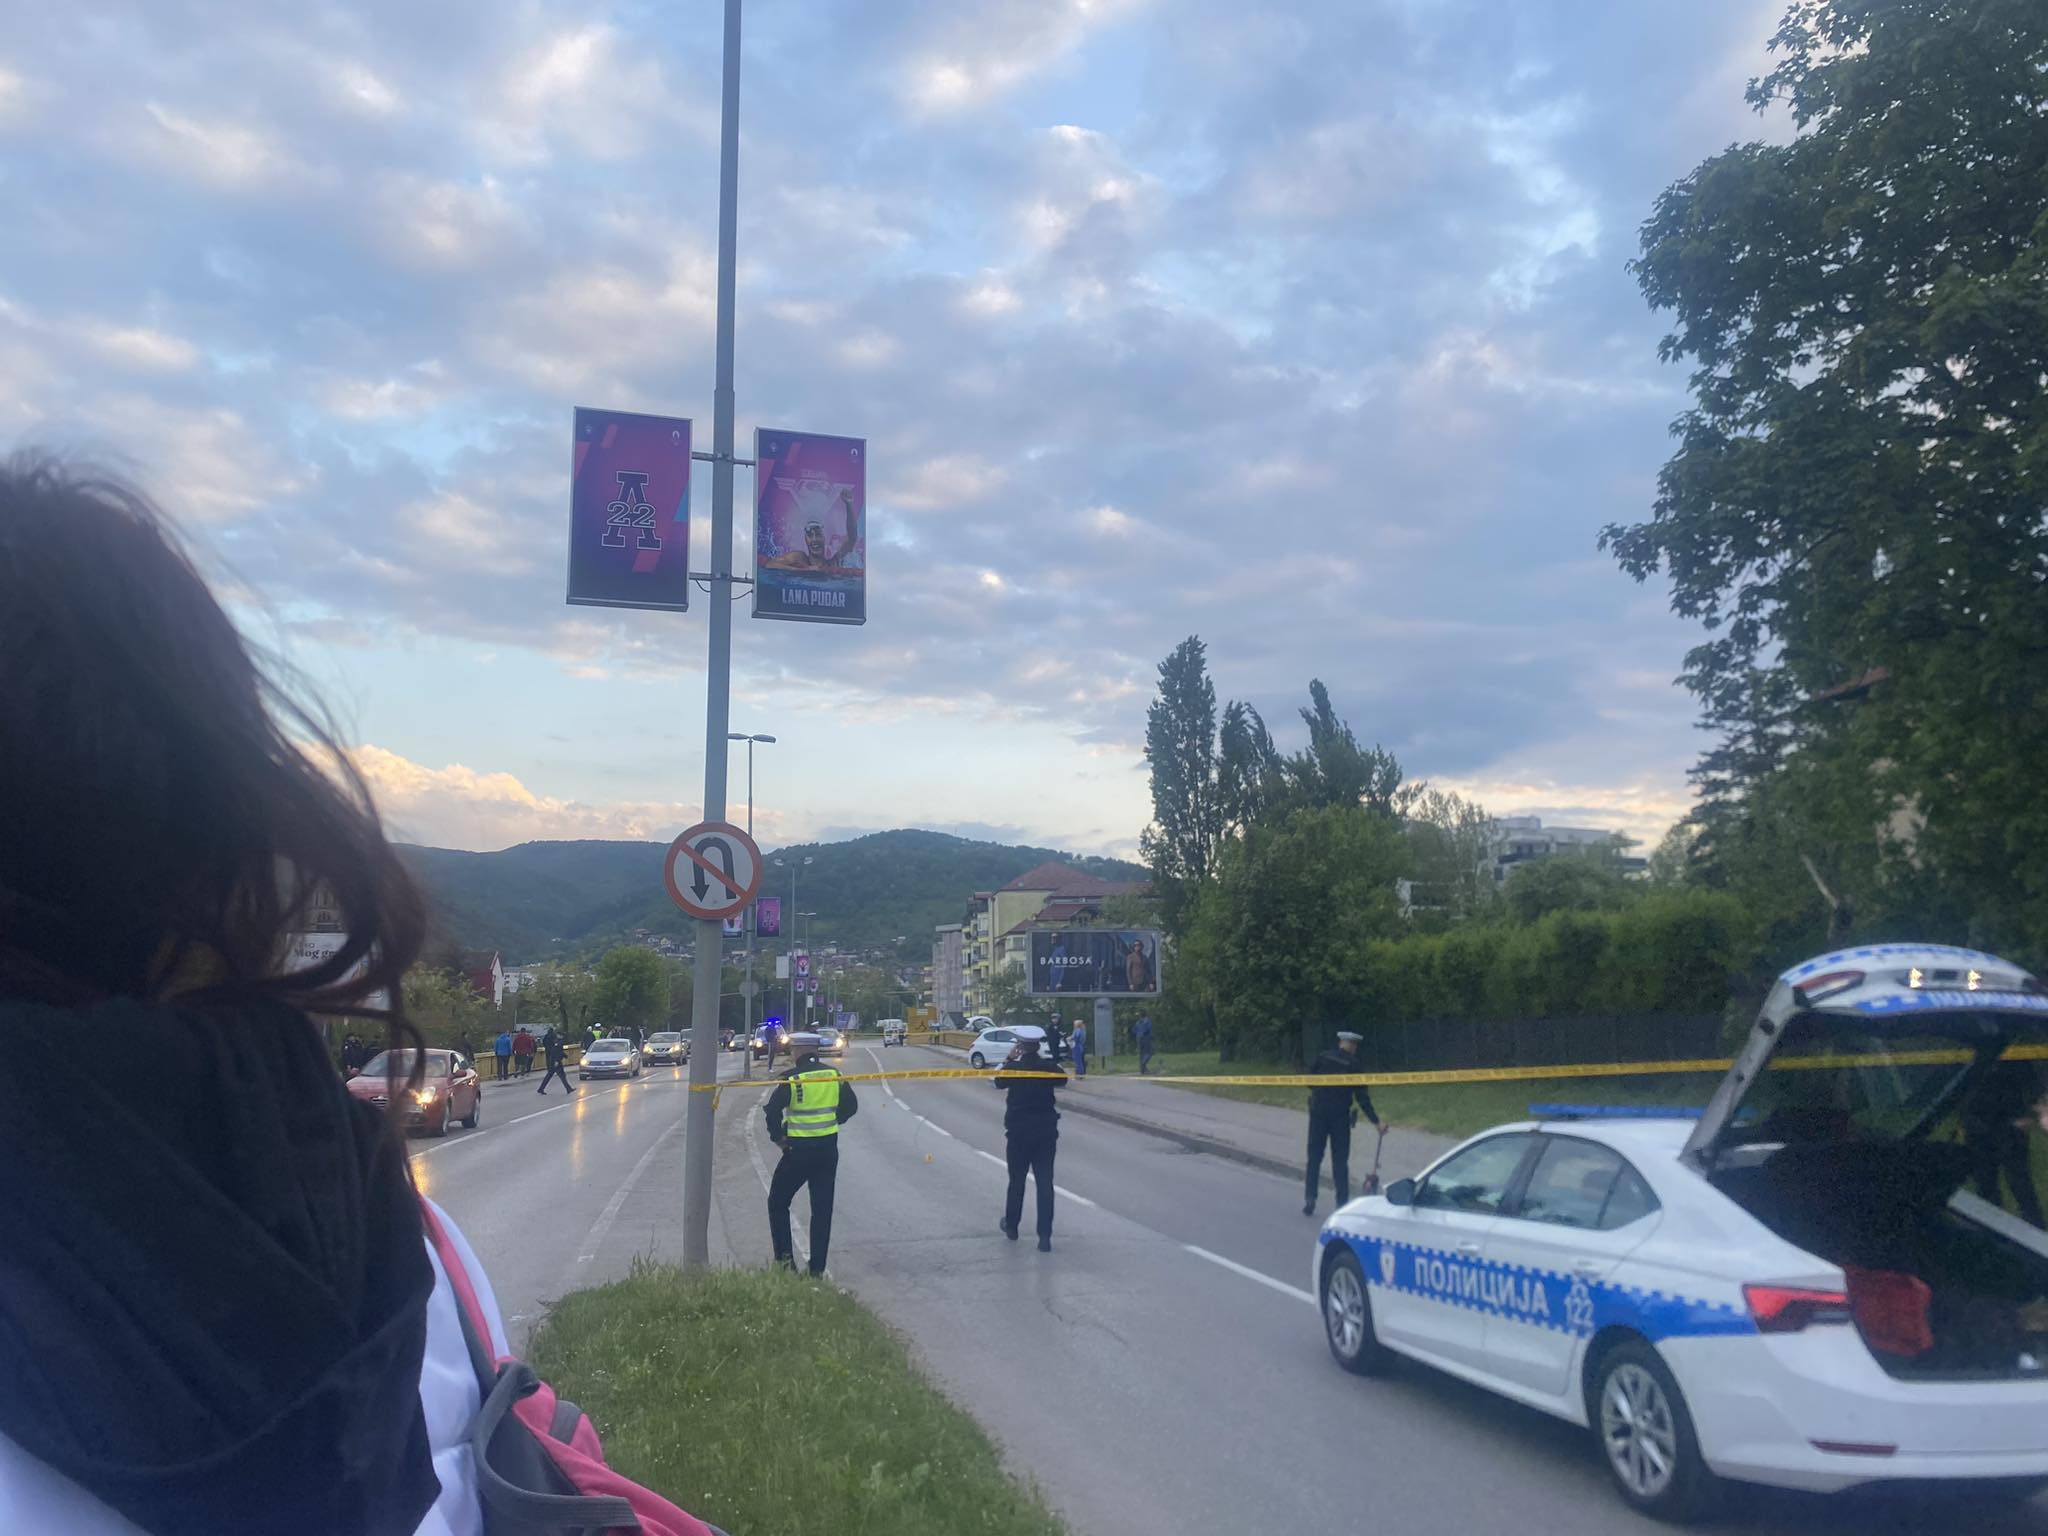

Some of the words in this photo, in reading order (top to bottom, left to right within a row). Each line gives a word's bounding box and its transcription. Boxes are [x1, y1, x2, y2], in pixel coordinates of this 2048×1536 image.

[606, 500, 656, 529] 22
[782, 588, 809, 606] LANA
[811, 590, 846, 608] PUDAR
[1040, 956, 1092, 965] BARBOSA
[1415, 1257, 1549, 1318] ПОЛИЦИЈА
[1564, 1296, 1595, 1329] 122
